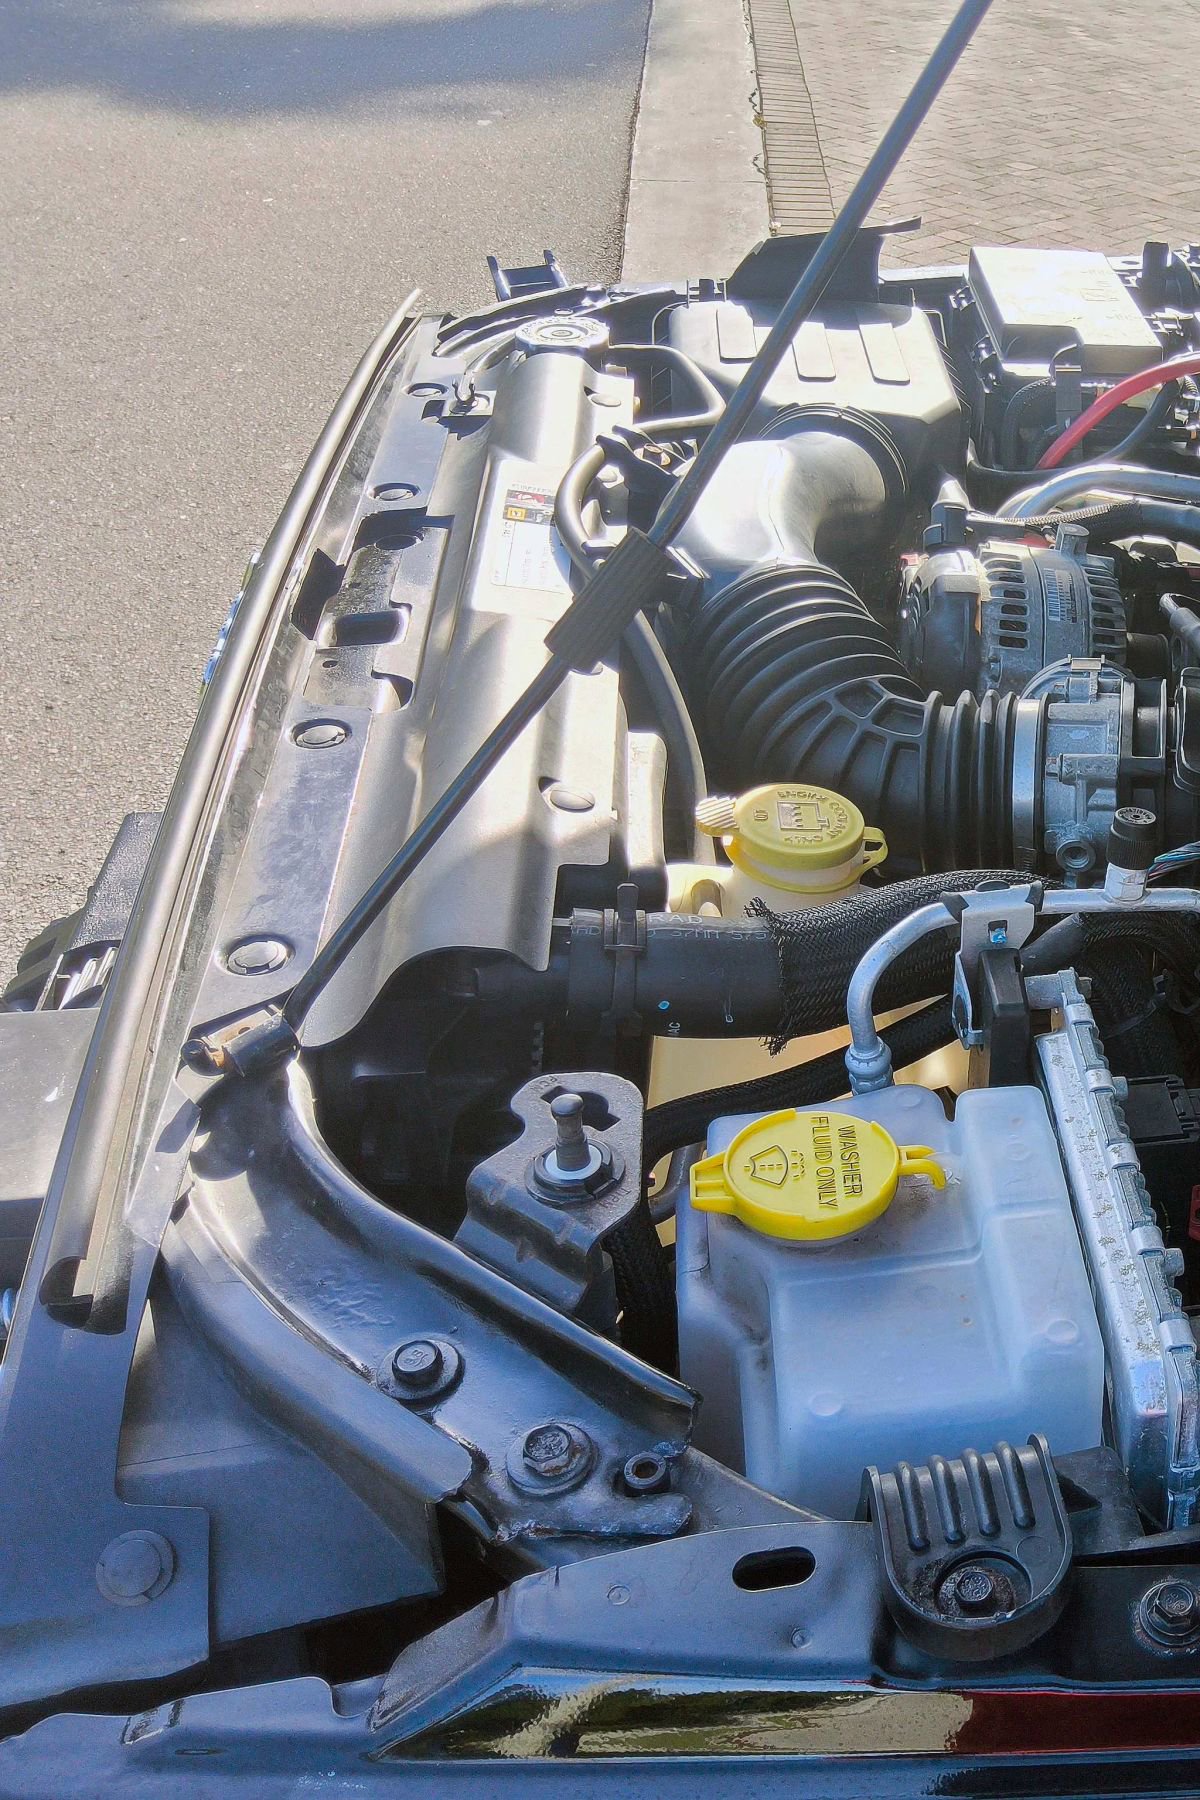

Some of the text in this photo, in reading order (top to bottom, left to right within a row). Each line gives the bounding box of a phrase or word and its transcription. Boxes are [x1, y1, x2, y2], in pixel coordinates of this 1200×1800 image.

[783, 834, 823, 845] ONLY
[649, 914, 703, 924] RAD
[810, 1116, 839, 1208] FLUID ONLY
[838, 1125, 863, 1195] WASHER
